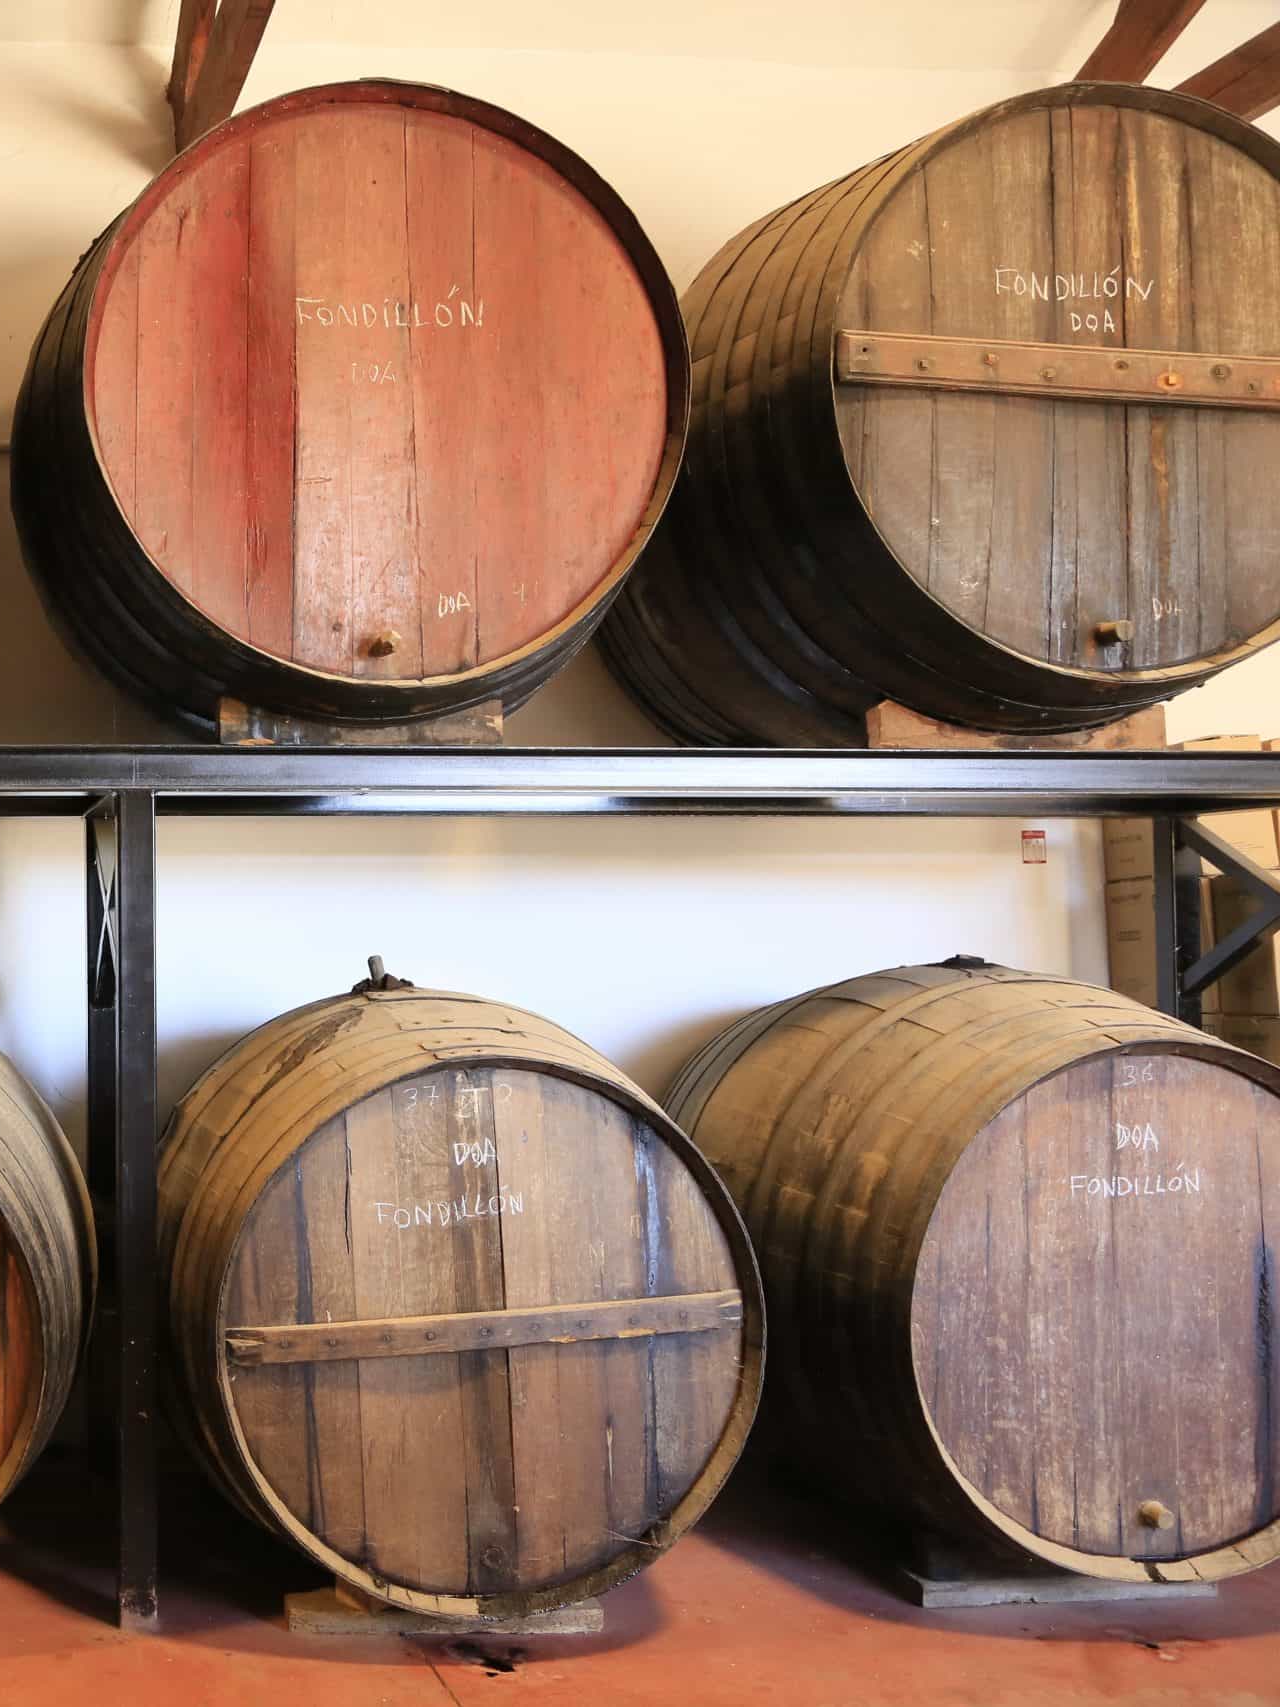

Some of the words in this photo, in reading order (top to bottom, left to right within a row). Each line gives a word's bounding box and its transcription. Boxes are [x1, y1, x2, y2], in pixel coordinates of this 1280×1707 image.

[995, 265, 1154, 301] FONDILLÓN
[296, 284, 485, 328] FONDILLÓN
[1071, 308, 1116, 333] DOA
[453, 1137, 497, 1168] DOA
[1116, 1121, 1160, 1153] DOA
[1070, 1162, 1201, 1199] FONDILLÓN
[373, 1184, 525, 1229] FONDILLÓN
